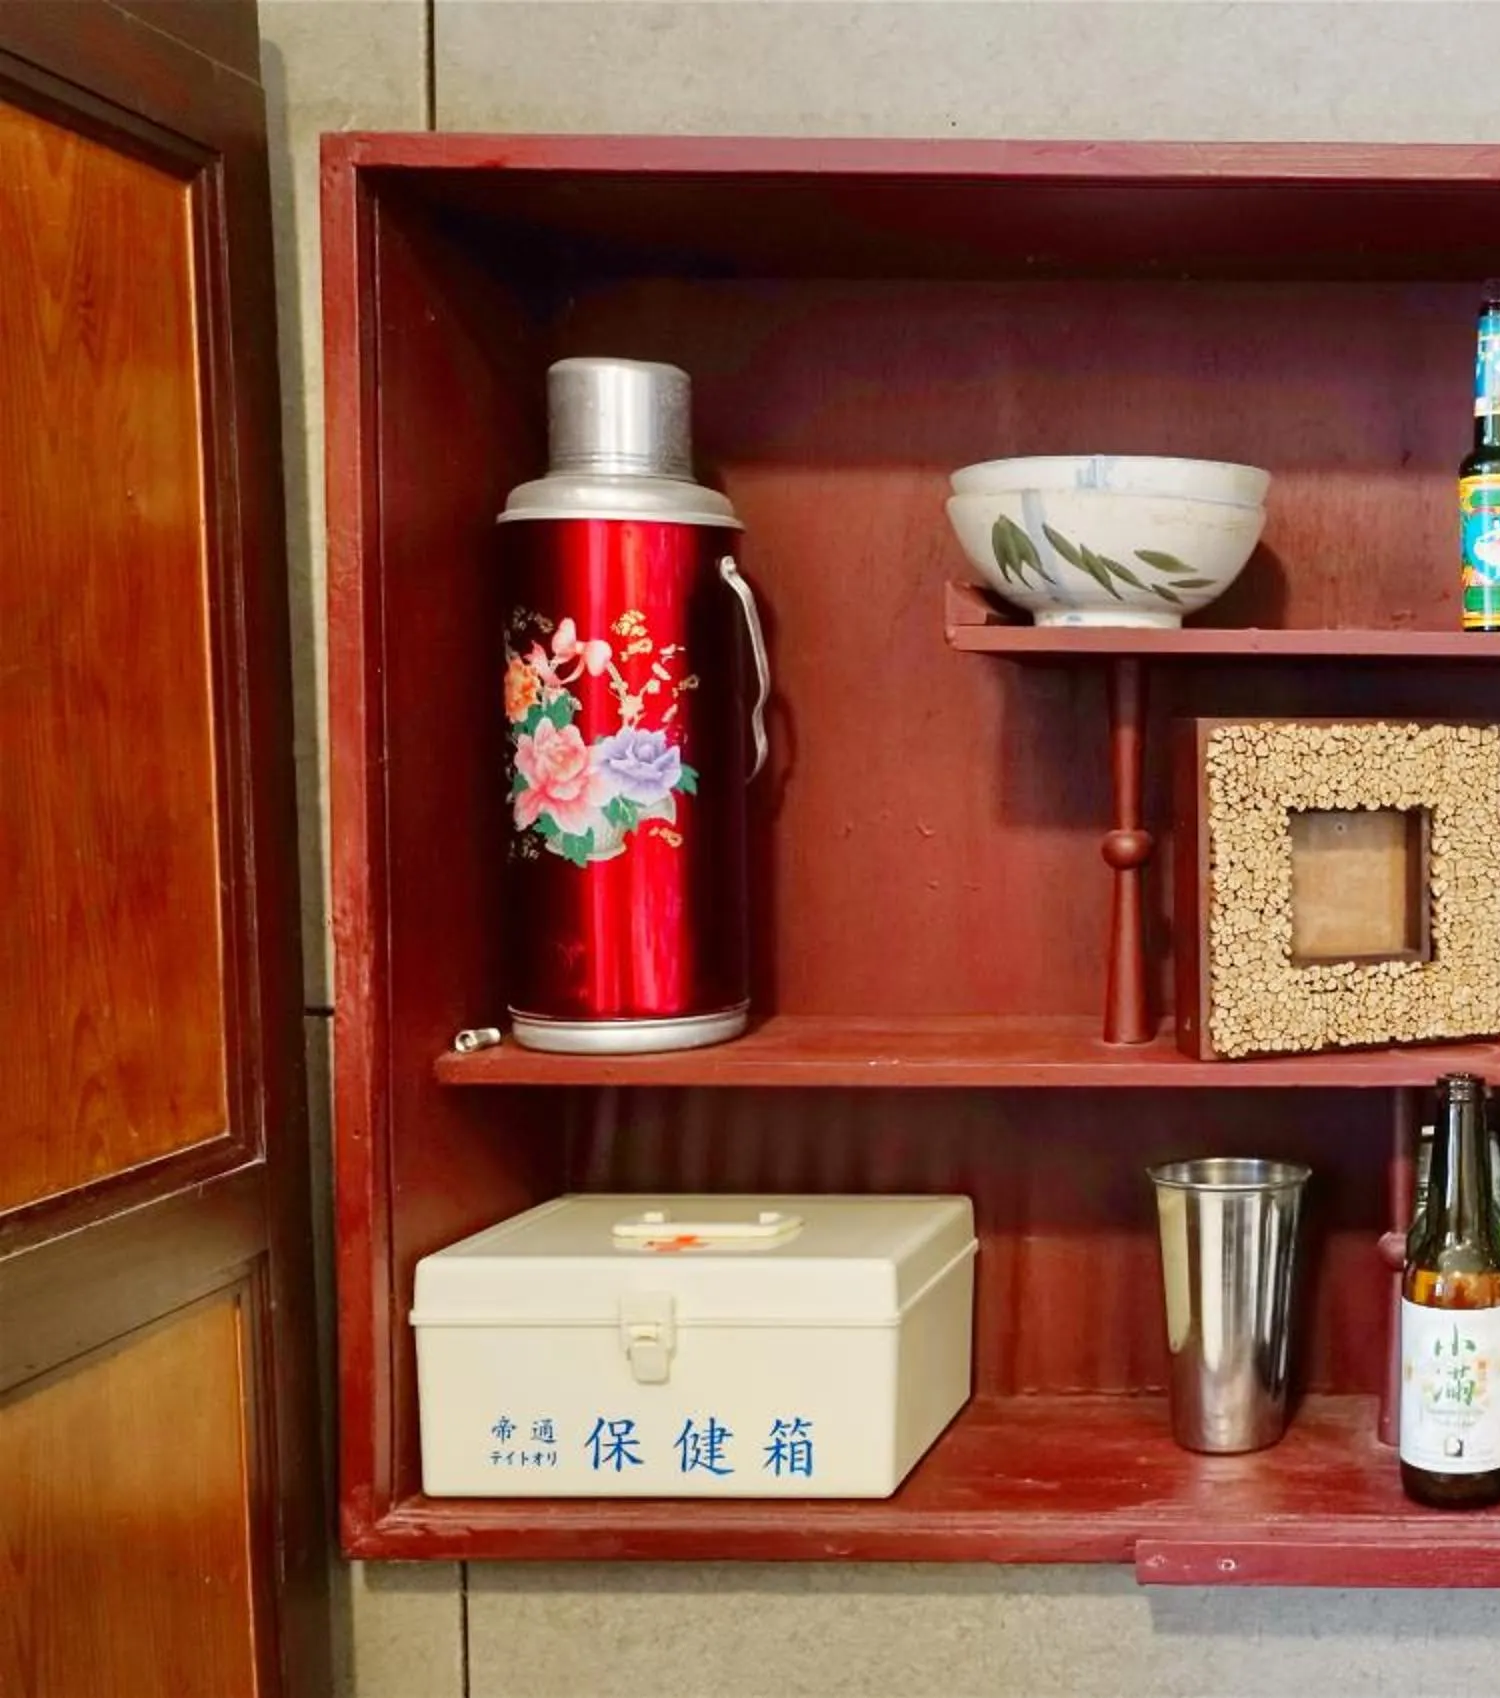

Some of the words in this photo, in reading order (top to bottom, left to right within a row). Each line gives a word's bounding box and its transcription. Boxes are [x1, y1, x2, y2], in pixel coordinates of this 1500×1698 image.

[491, 1415, 556, 1445] 帝通
[489, 1450, 558, 1468] テイトオリ
[584, 1416, 814, 1478] 保健箱
